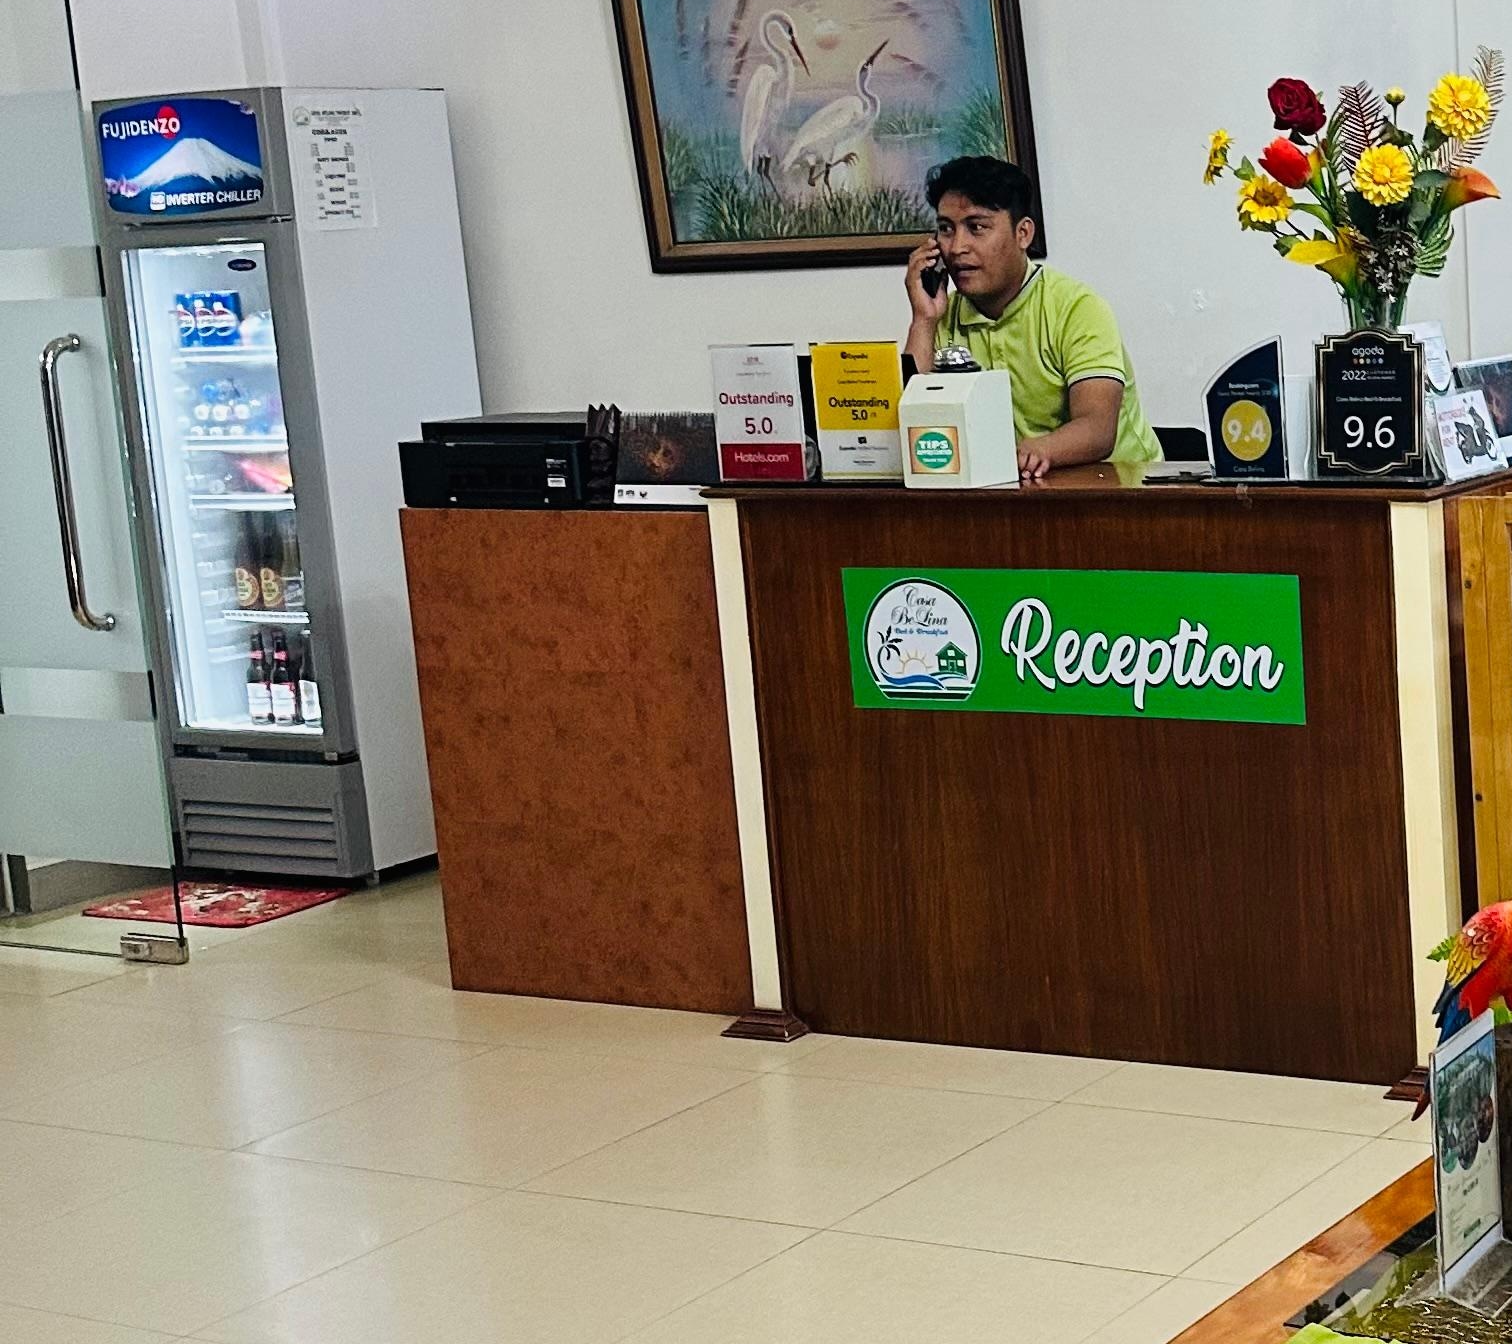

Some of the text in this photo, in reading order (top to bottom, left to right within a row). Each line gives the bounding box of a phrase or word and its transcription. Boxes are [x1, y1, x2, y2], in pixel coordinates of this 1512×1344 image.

[102, 117, 181, 140] FUJIDENZO
[166, 191, 214, 207] INVERTER
[216, 189, 262, 204] CHILLER
[1351, 346, 1385, 357] agoda
[1341, 370, 1367, 381] 2022
[719, 391, 794, 407] Outstanding
[828, 396, 890, 410] Outstanding
[851, 409, 868, 421] 5.0
[744, 417, 773, 434] 5.0
[1227, 419, 1266, 443] 9.4
[1343, 415, 1396, 449] 9.6
[918, 440, 948, 450] TIPS
[734, 452, 789, 463] Hotels.com
[903, 585, 936, 607] Casa
[1001, 597, 1284, 709] Reception
